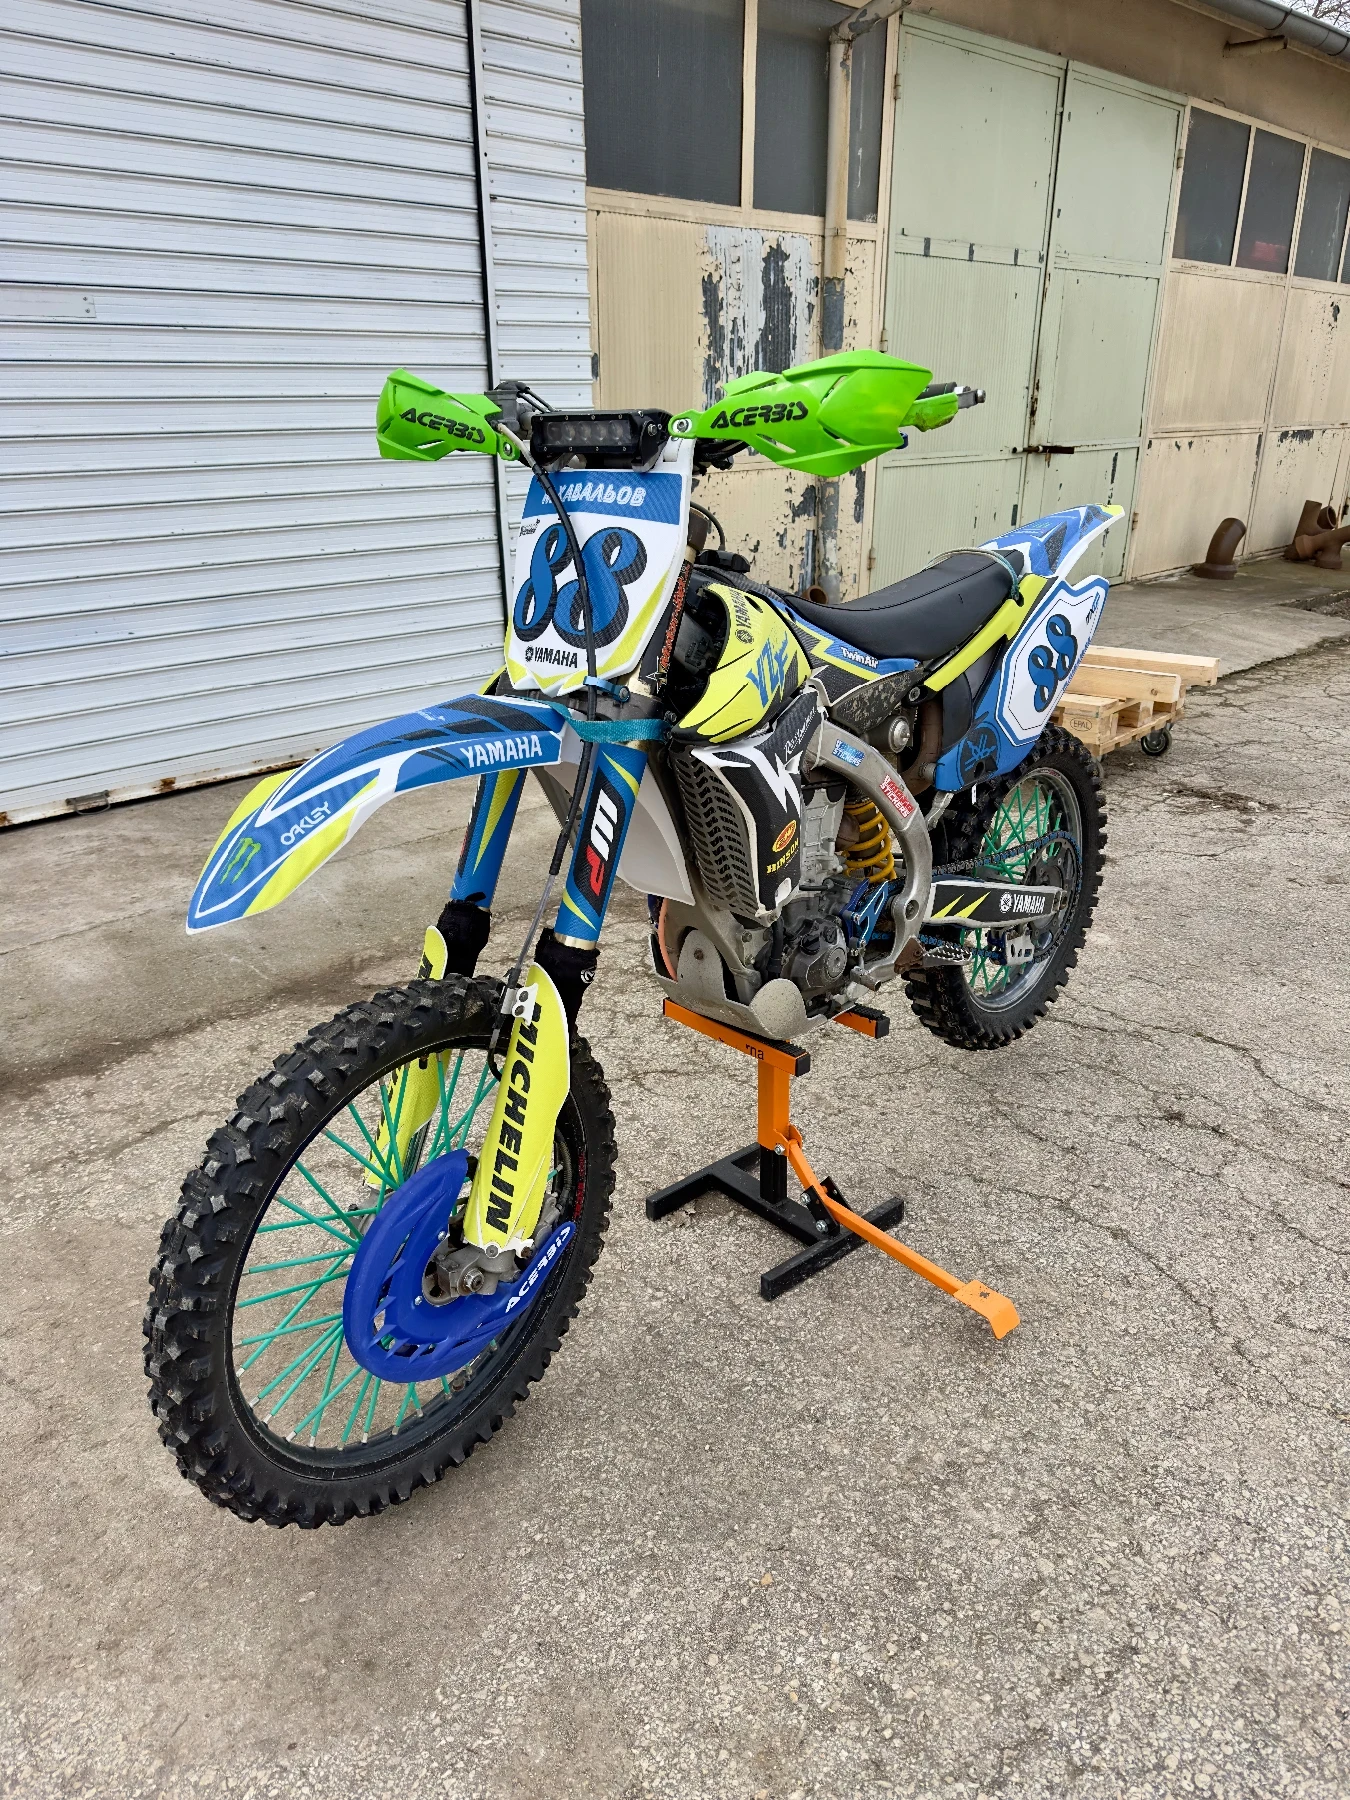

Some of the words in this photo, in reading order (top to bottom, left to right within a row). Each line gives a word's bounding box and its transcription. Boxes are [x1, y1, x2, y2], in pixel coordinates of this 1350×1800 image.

[399, 406, 486, 444] ACERBIS
[709, 401, 809, 429] ACERBIS
[513, 523, 648, 649] 88
[533, 646, 578, 669] YAMAHA
[1028, 613, 1078, 713] 88
[1073, 718, 1090, 730] EPAL
[459, 734, 543, 768] YAMAHA
[280, 801, 330, 846] OAKLEY
[1012, 893, 1046, 914] YAMAHA
[486, 1001, 543, 1234] MICHELIN
[505, 1226, 570, 1313] ACERBIS
